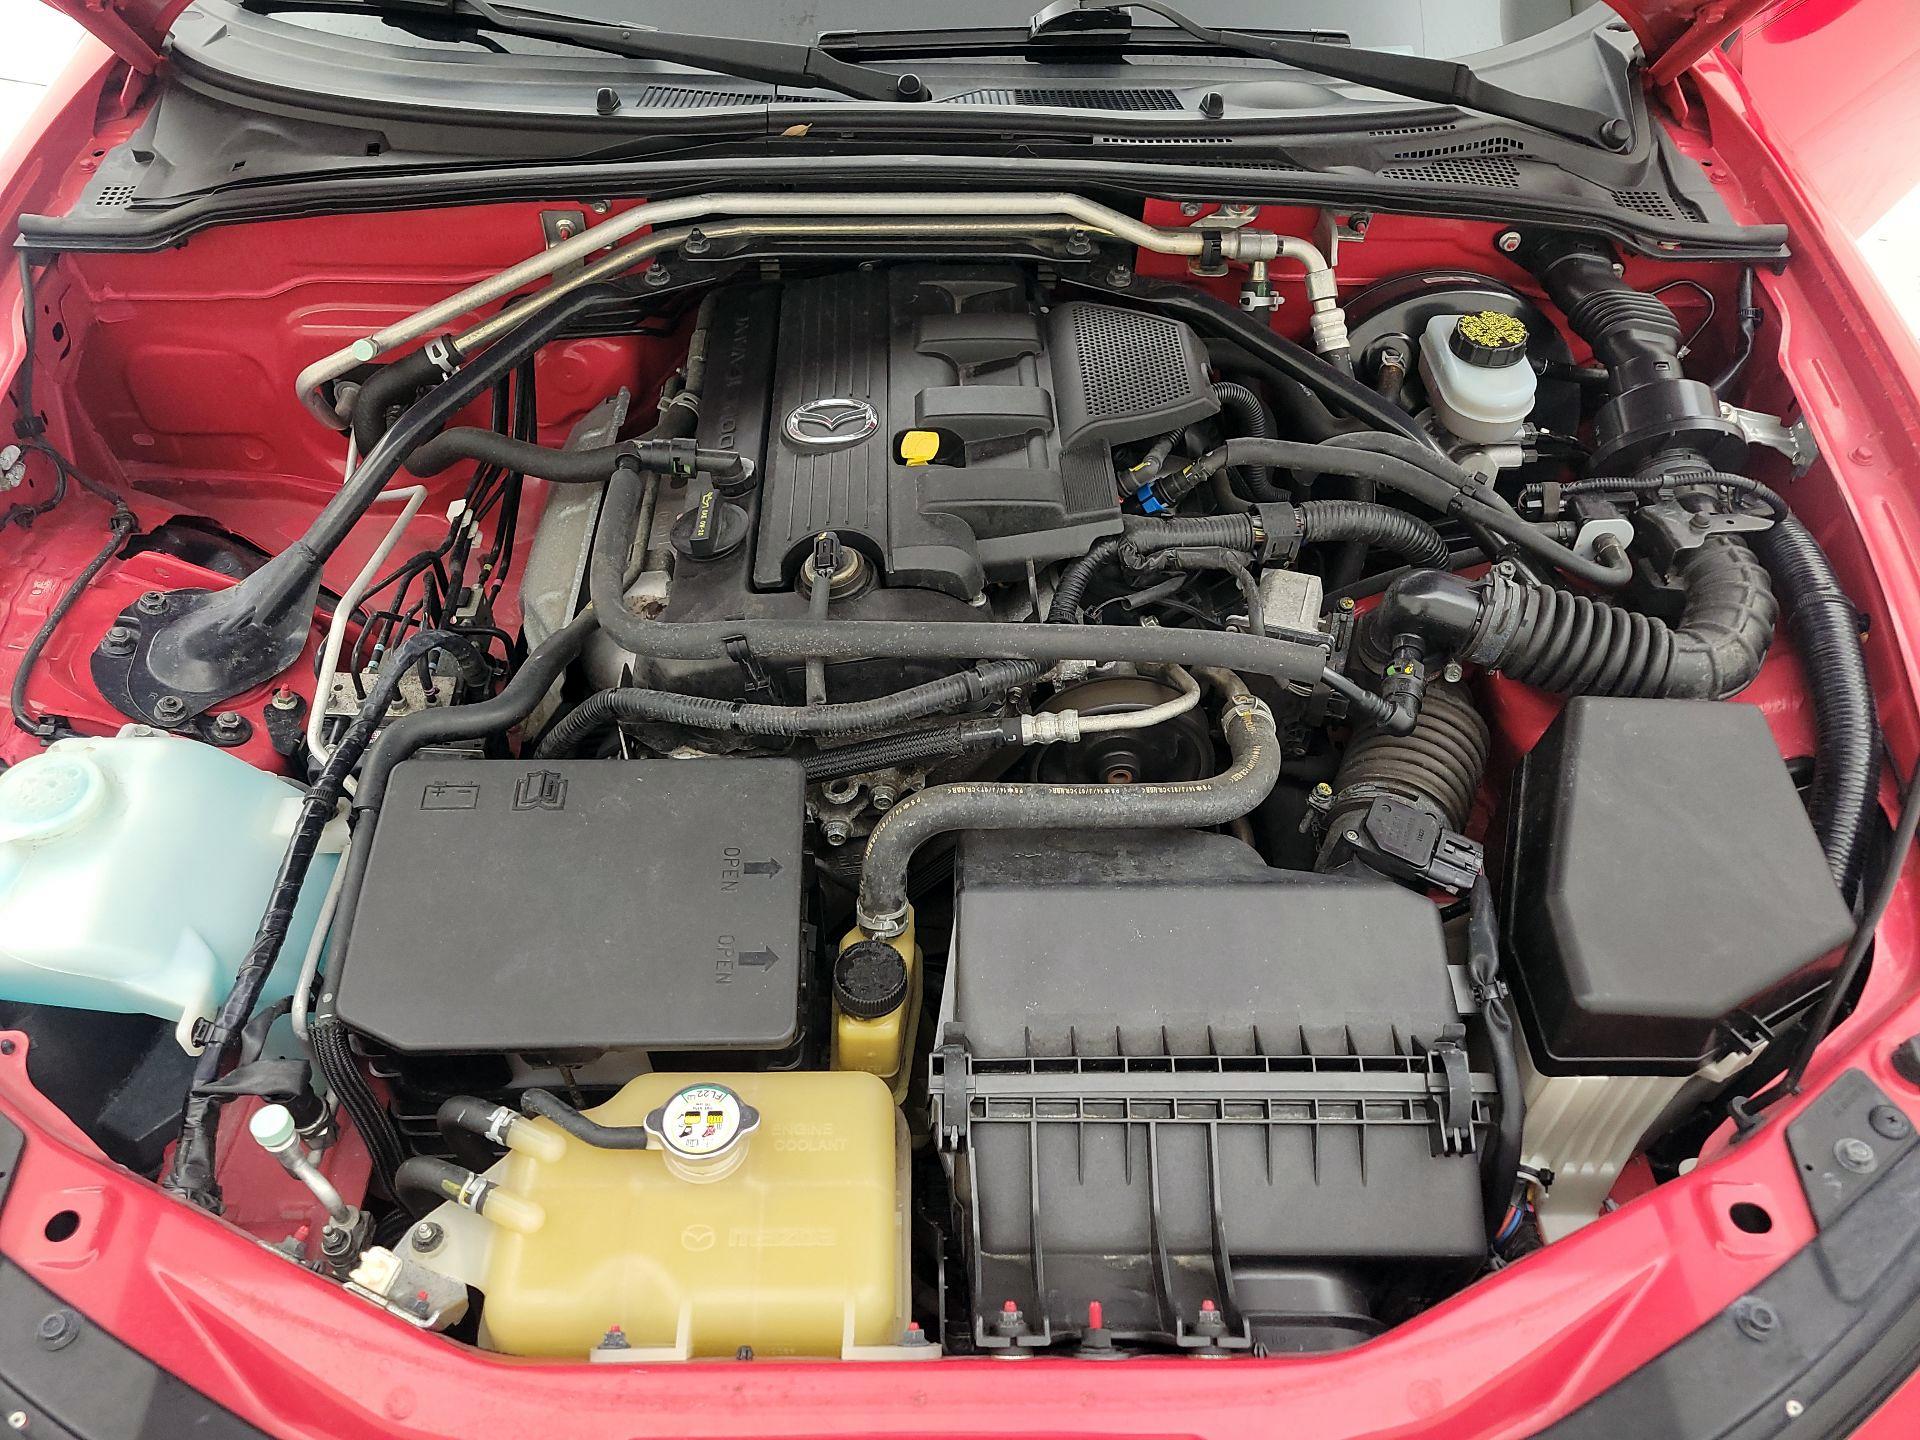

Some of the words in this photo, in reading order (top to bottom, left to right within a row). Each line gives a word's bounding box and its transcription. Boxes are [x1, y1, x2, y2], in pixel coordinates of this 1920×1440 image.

[720, 847, 741, 892] OPEN
[715, 935, 736, 984] OPEN
[696, 1090, 724, 1101] FL22
[772, 1122, 833, 1136] ENGINE
[773, 1138, 848, 1152] COOLANT
